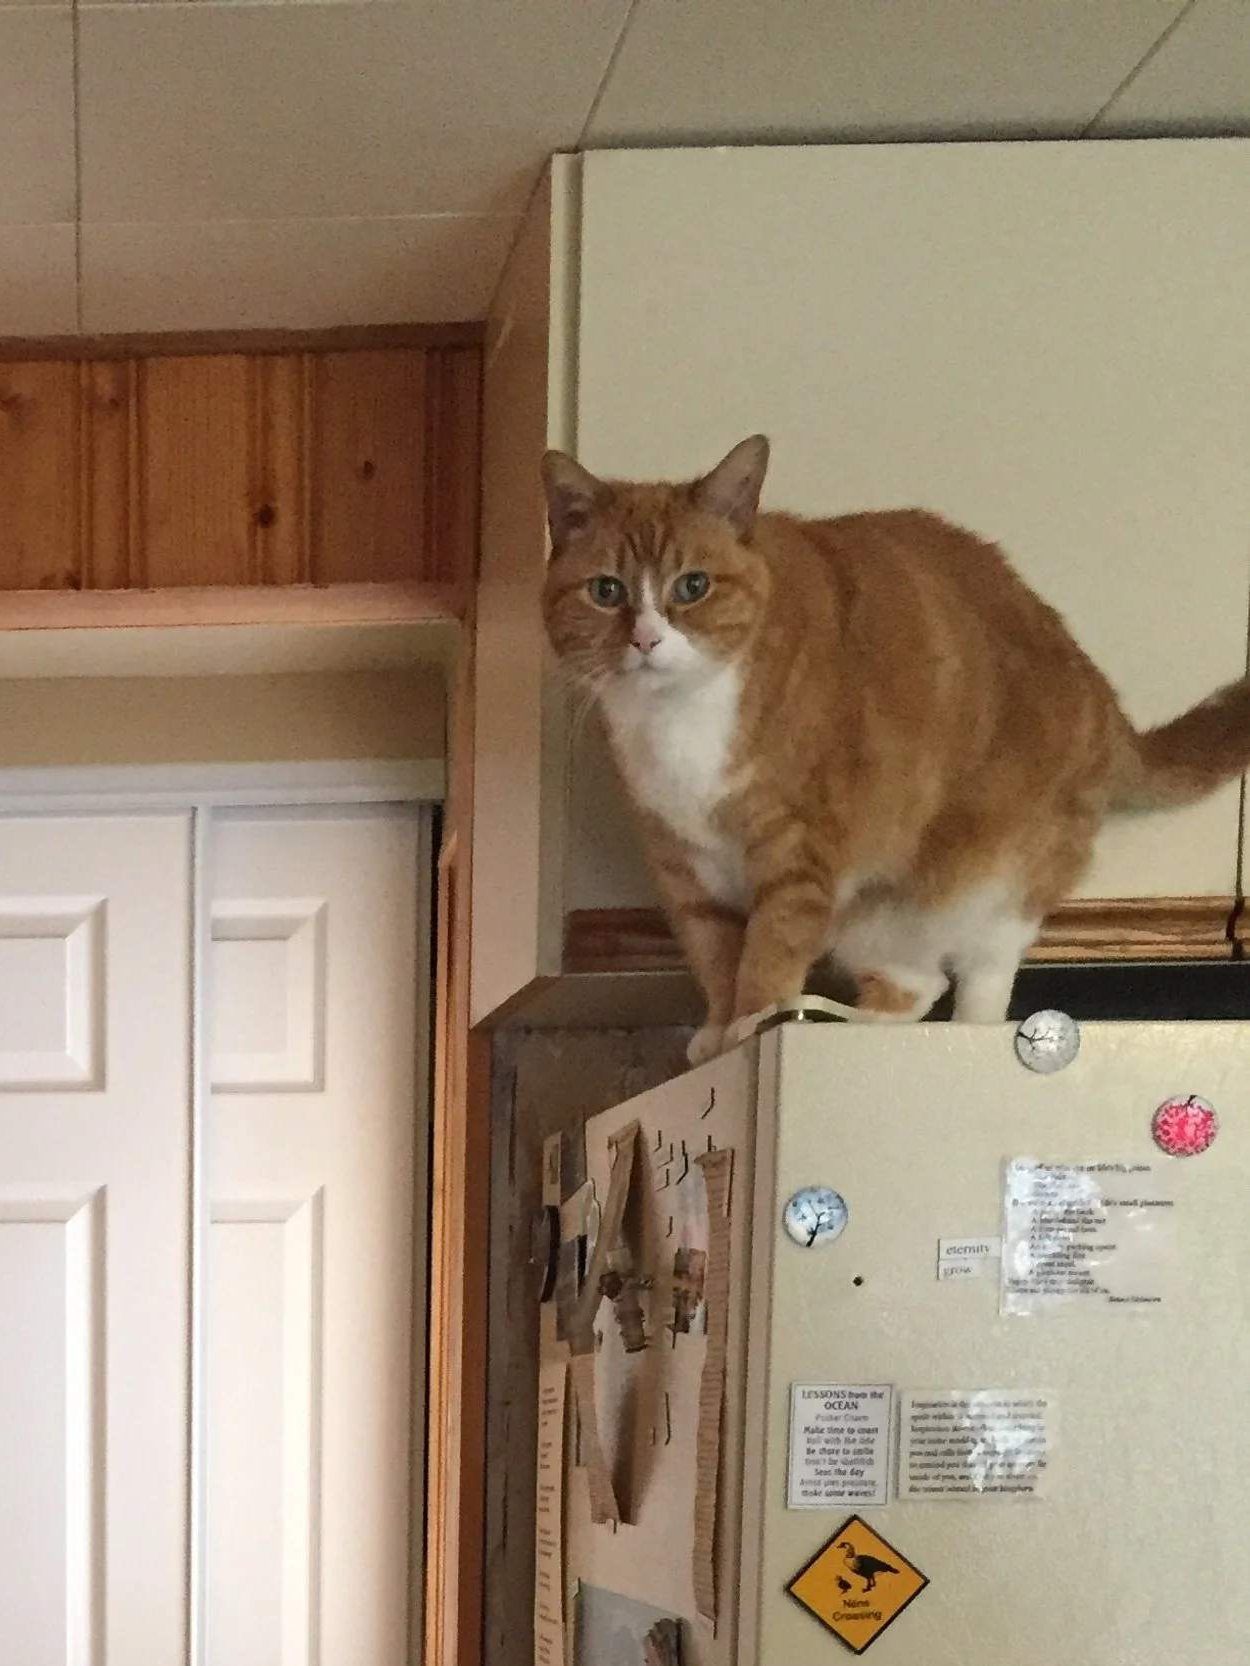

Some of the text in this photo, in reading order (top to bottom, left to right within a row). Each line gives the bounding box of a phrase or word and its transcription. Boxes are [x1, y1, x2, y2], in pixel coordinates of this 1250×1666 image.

[802, 1389, 884, 1399] LESSONS from the
[824, 1401, 859, 1410] OCEAN
[803, 1425, 825, 1434] Make
[827, 1426, 844, 1434] time
[846, 1426, 855, 1434] to
[834, 1468, 846, 1476] the
[849, 1468, 865, 1478] day
[832, 1611, 882, 1621] Crossing
